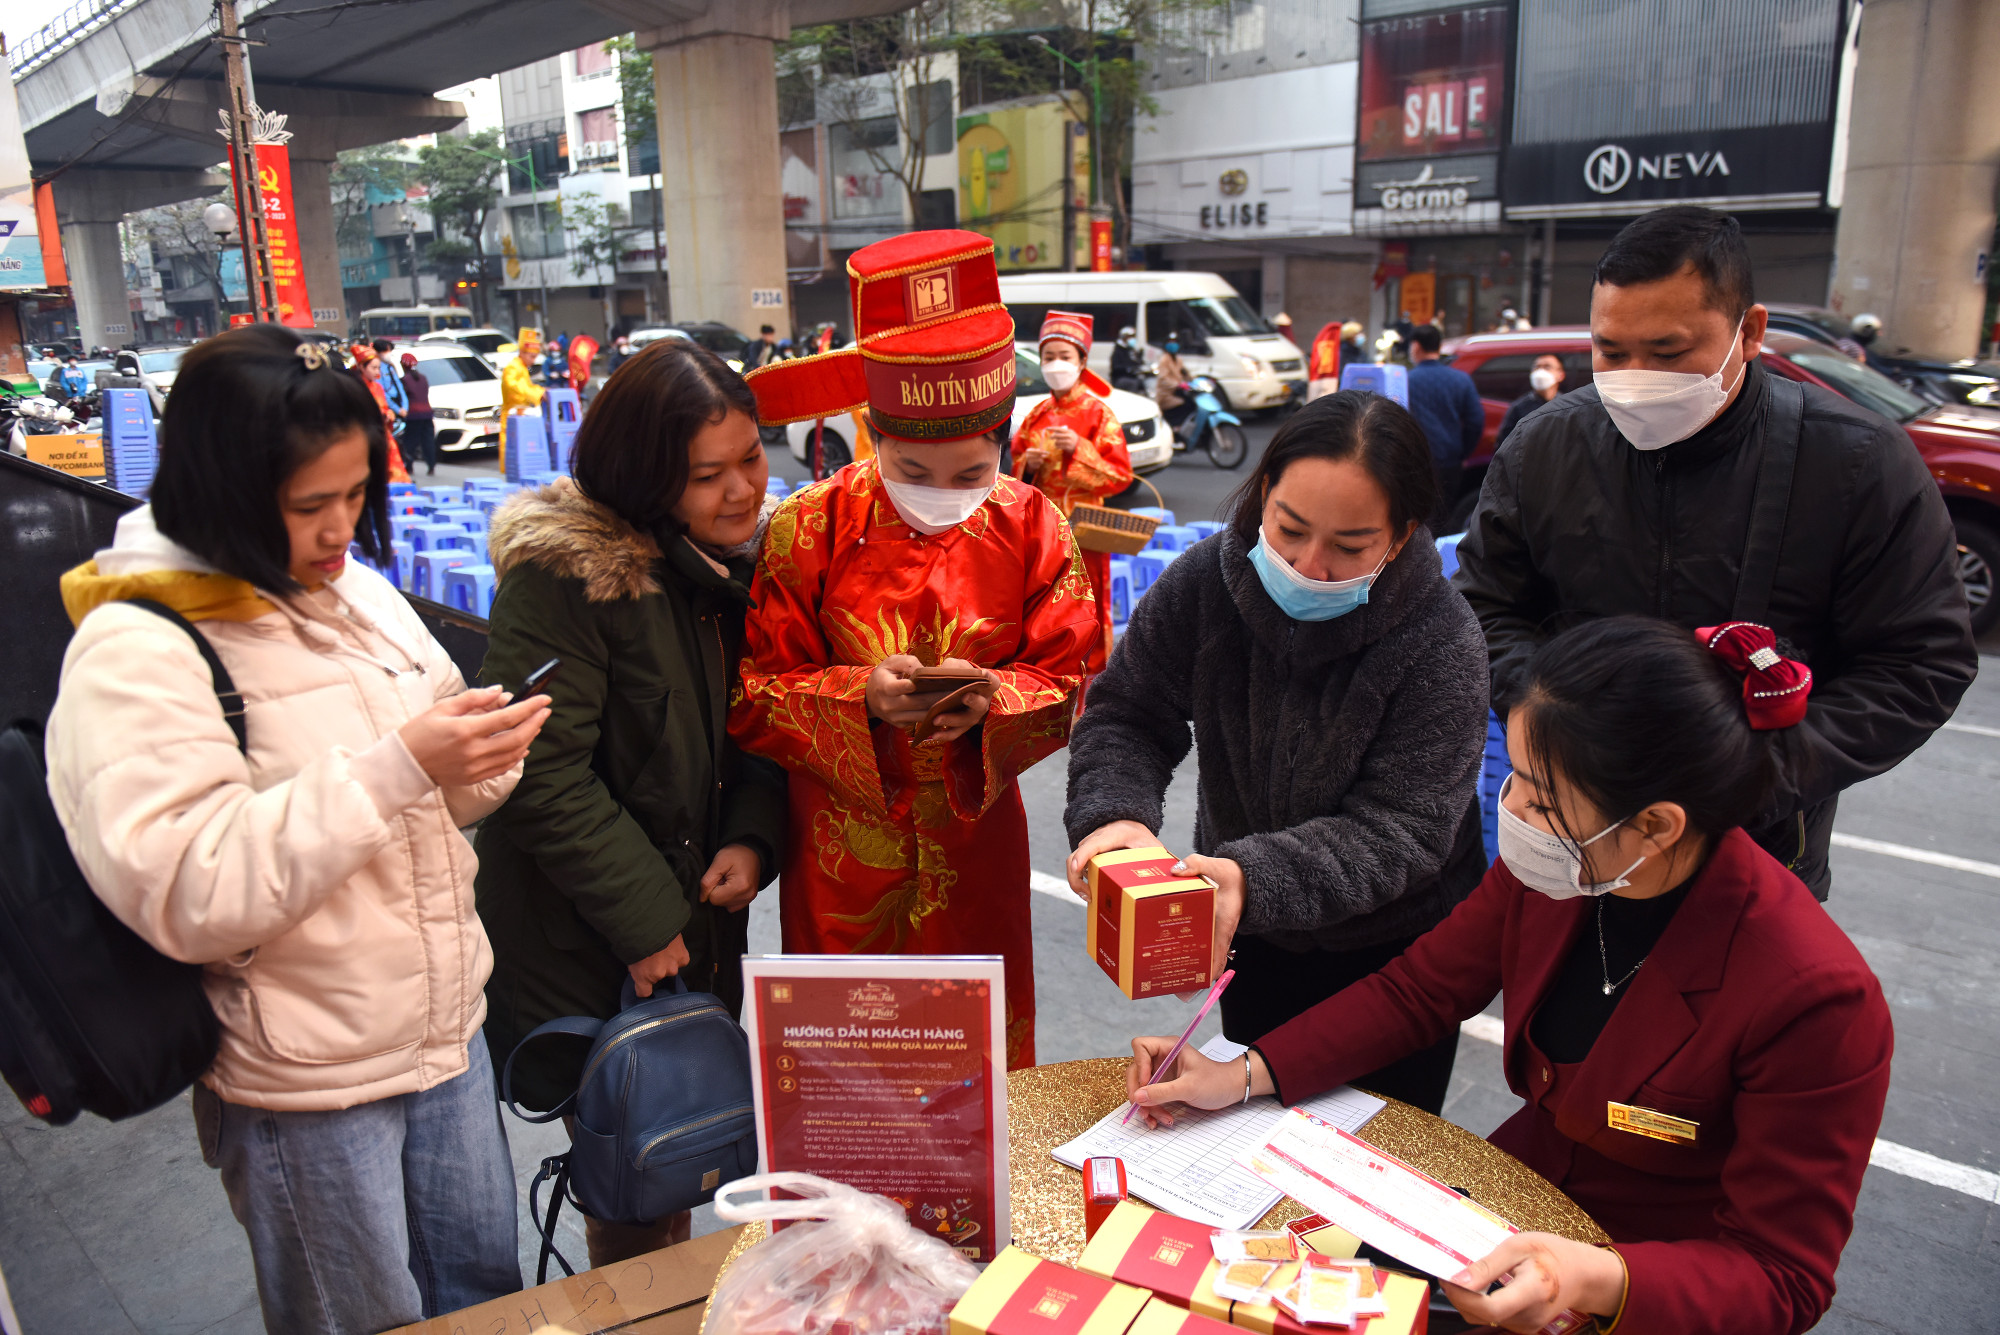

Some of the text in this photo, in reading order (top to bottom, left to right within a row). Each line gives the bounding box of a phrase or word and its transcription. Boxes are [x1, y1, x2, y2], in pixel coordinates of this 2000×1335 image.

[1404, 85, 1485, 138] SALE
[1637, 151, 1730, 181] NEVA
[1381, 187, 1468, 210] Germe
[1201, 202, 1268, 229] ELISE
[314, 310, 338, 320] P333
[900, 372, 935, 407] BẢO
[937, 372, 967, 406] TÍN
[969, 366, 1001, 403] MINH
[784, 1024, 964, 1040] HƯỚNG DẪN KHÁCH HÀNG
[824, 1040, 850, 1048] THẦN
[852, 1040, 870, 1050] TÀI,
[872, 1040, 899, 1050] NHẬN
[901, 1040, 922, 1050] QUÀ
[924, 1042, 944, 1050] MAY
[946, 1040, 968, 1050] MẮN
[782, 1058, 788, 1068] 1
